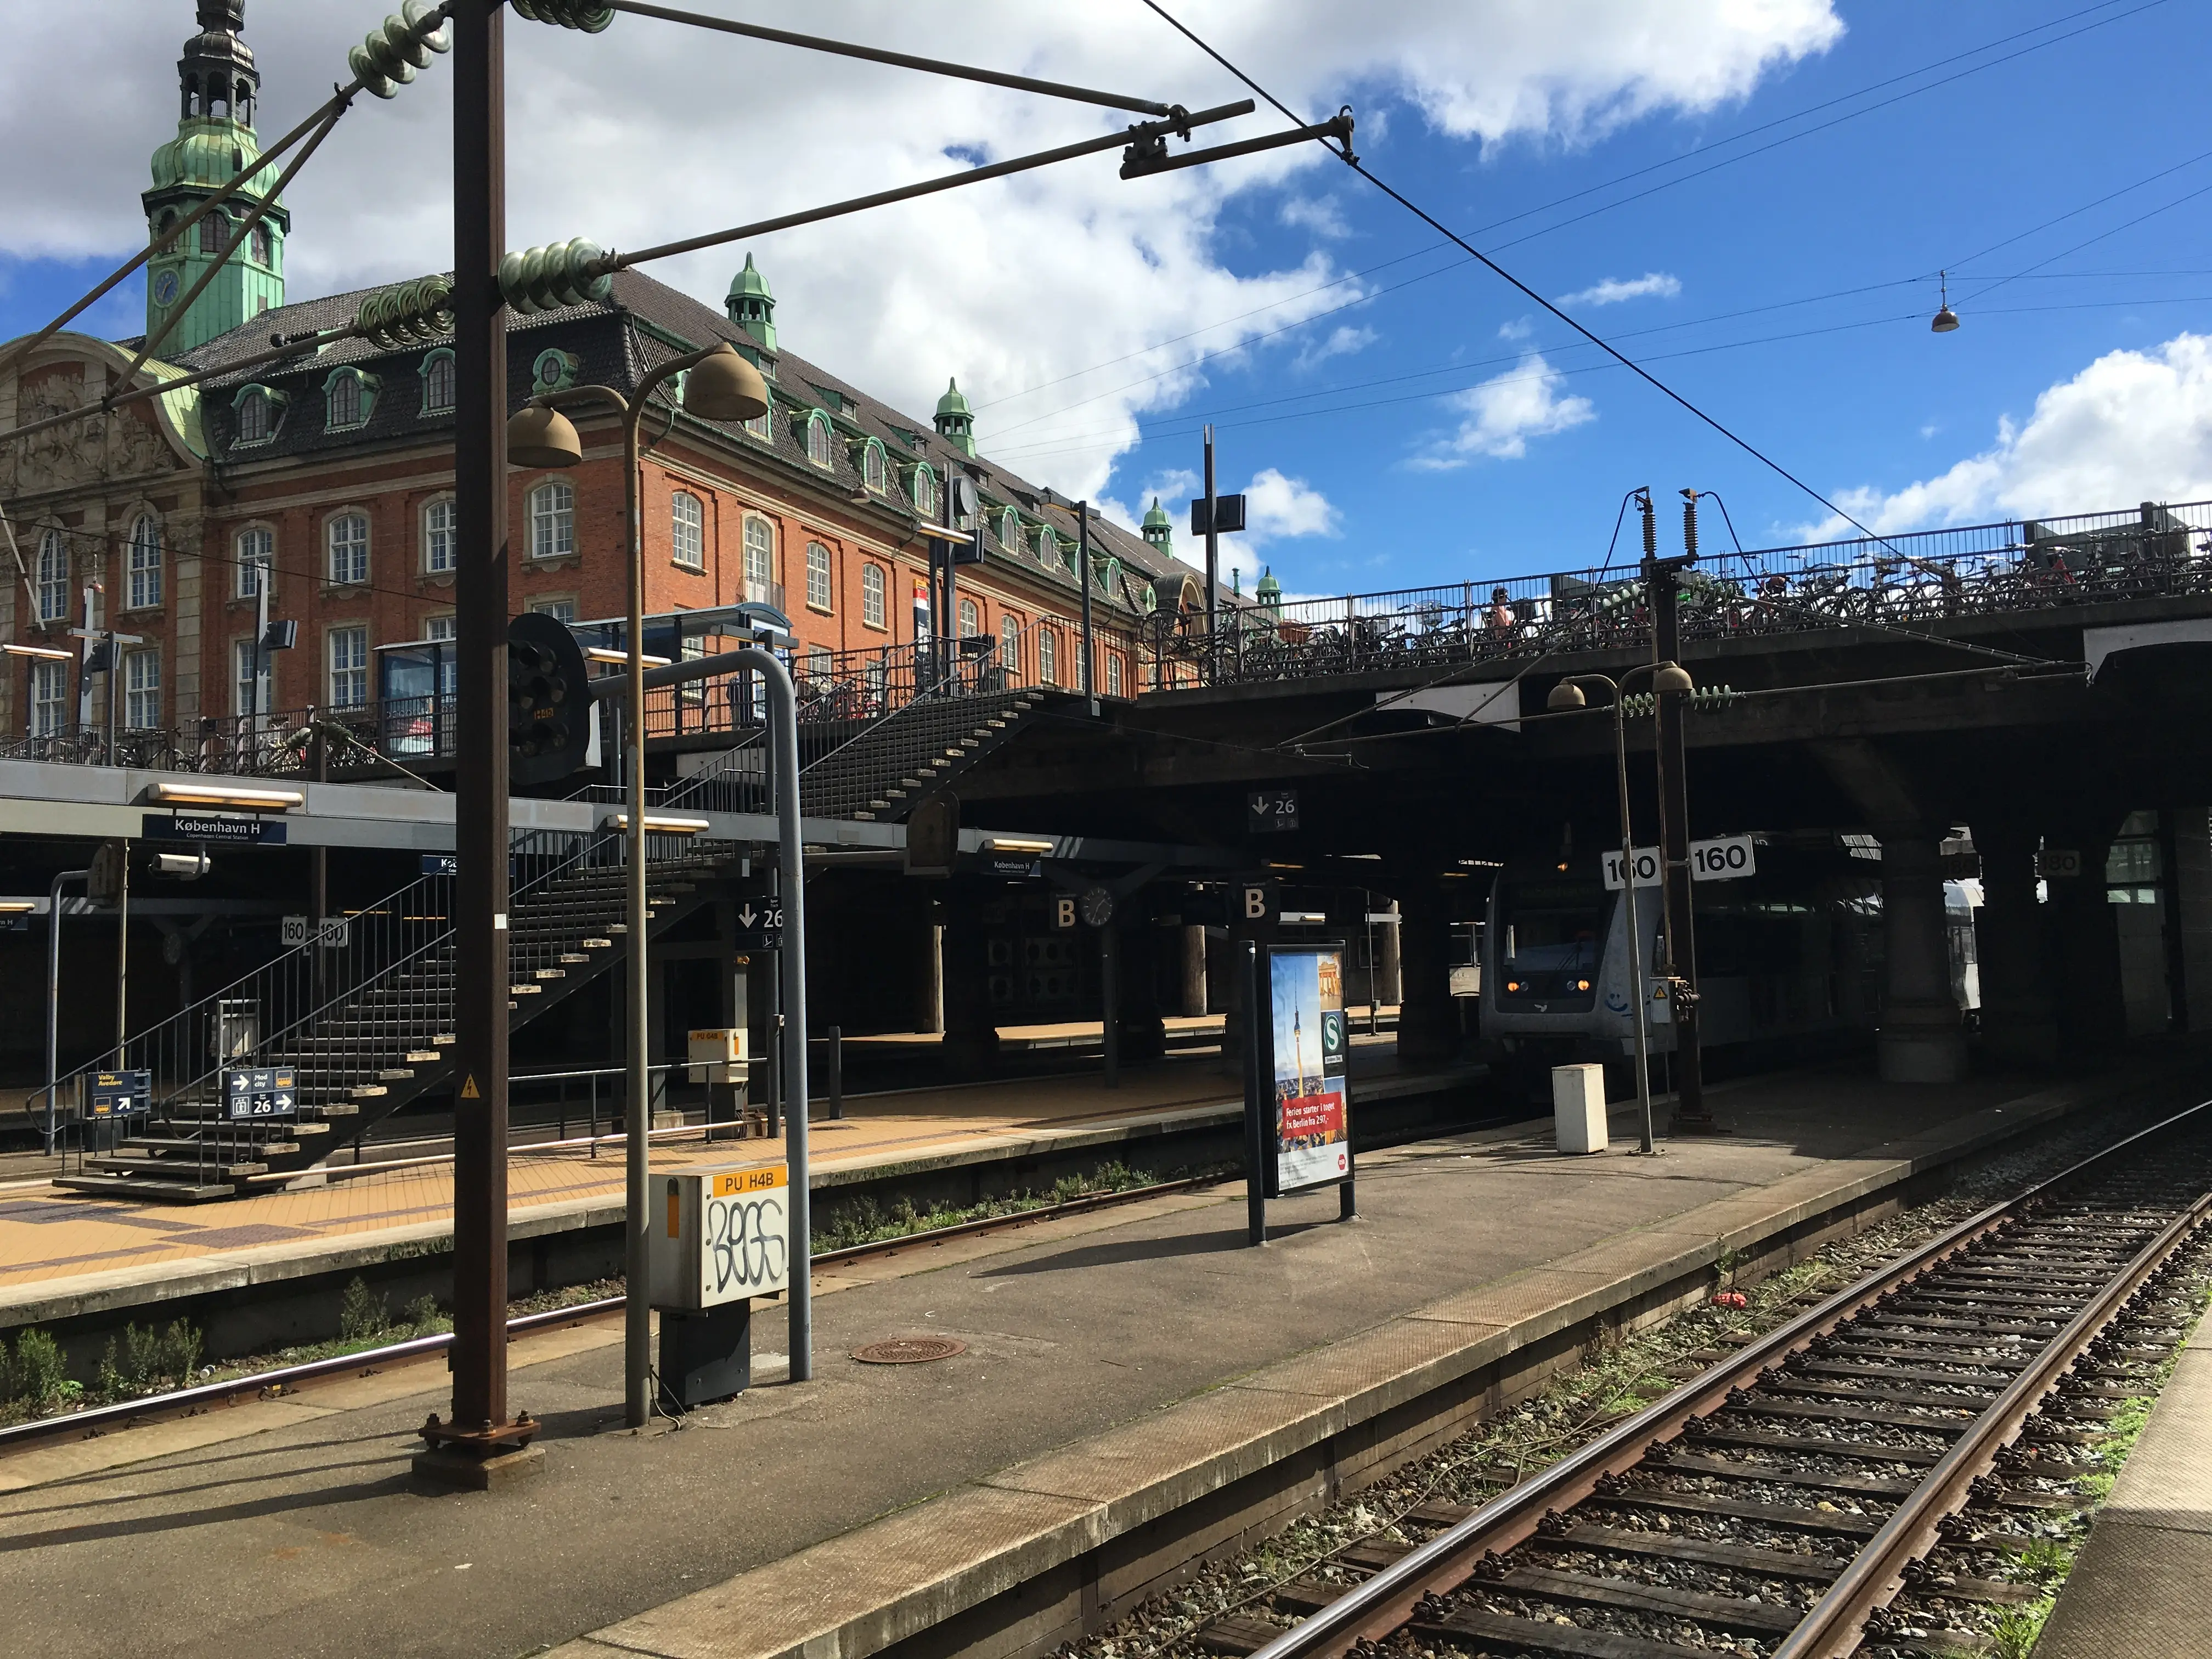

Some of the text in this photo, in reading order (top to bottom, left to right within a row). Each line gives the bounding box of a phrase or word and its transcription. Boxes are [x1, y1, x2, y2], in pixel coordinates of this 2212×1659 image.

[1276, 800, 1295, 814] 26
[175, 819, 260, 834] København H
[994, 861, 1024, 870] København
[1695, 845, 1746, 872] 160
[1607, 855, 1656, 882] 160
[1245, 889, 1265, 918] B
[764, 909, 783, 928] 26
[1058, 899, 1075, 928] B
[284, 922, 304, 940] 160
[1327, 1018, 1339, 1050] S
[254, 1100, 271, 1114] 26
[1286, 1102, 1335, 1117] Ferien starter i toget
[1286, 1120, 1293, 1130] fx
[1293, 1118, 1308, 1128] Berlin
[1316, 1114, 1329, 1125] 297,-
[725, 1172, 774, 1192] PU H4B
